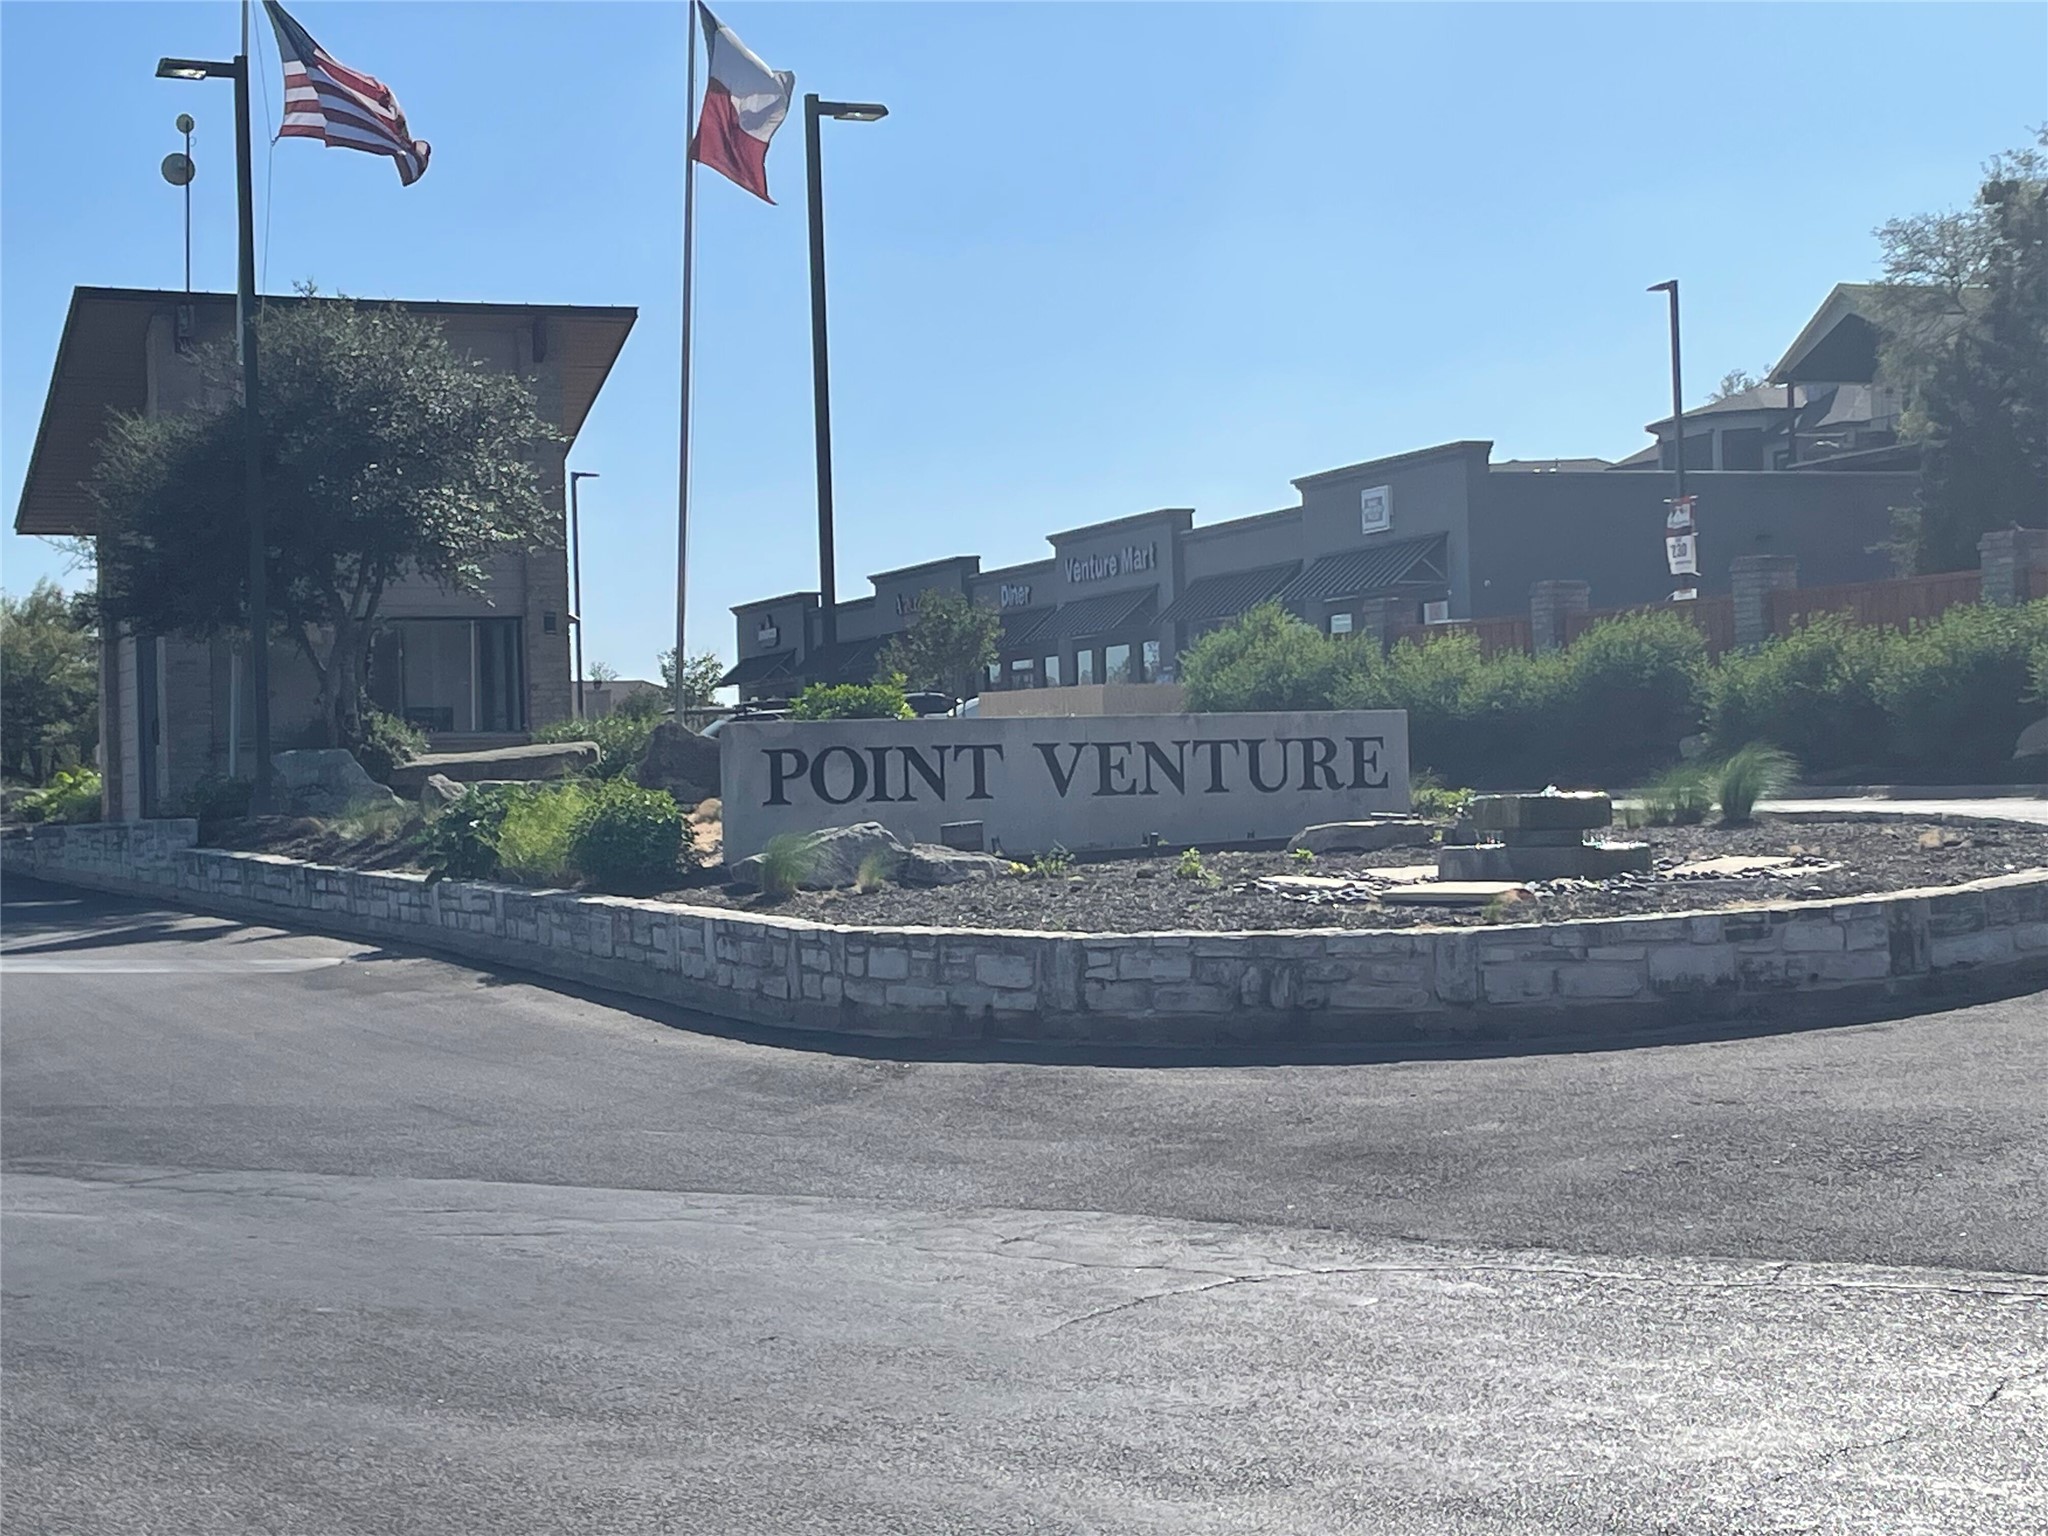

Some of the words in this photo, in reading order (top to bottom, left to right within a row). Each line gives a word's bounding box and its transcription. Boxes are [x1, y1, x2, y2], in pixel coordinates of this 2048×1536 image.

[1065, 554, 1118, 584] Venture
[1121, 542, 1156, 574] Mart
[1000, 583, 1031, 608] Diner
[762, 744, 1004, 807] POINT
[1033, 736, 1389, 799] VENTURE
